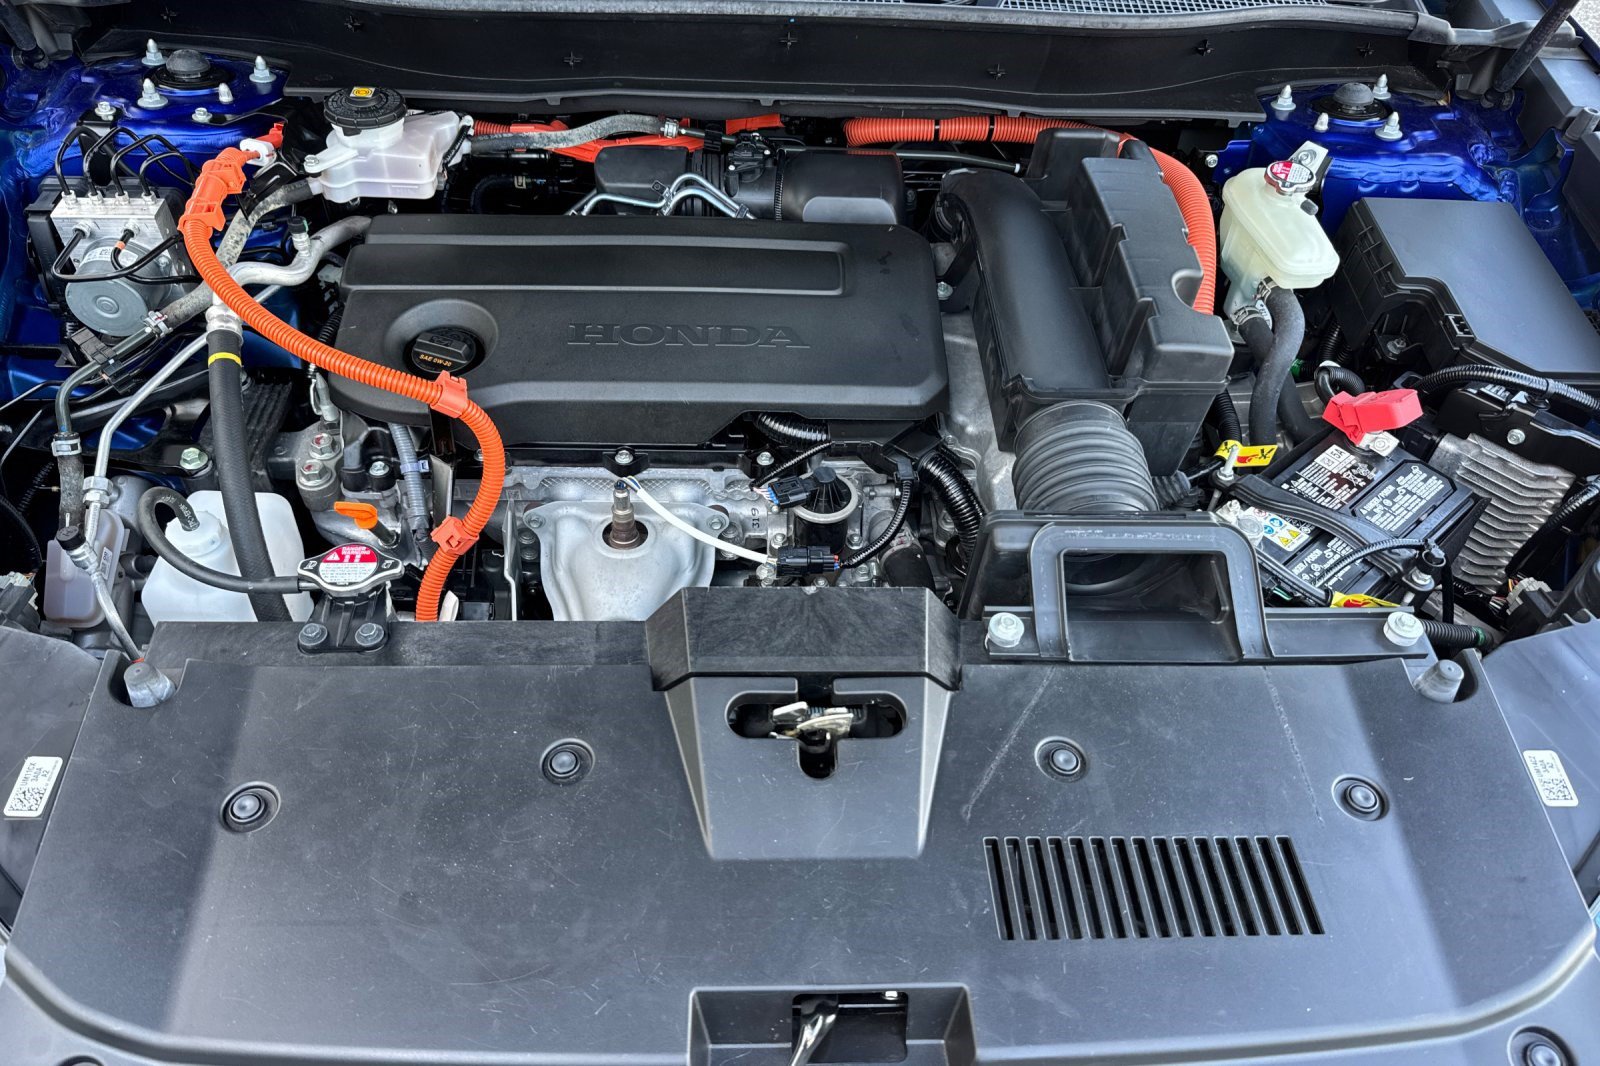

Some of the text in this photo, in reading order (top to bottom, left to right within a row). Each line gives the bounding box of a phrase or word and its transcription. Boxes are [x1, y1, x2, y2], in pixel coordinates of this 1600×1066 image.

[567, 322, 811, 349] HONDA
[419, 354, 453, 367] SAE 0W-20
[750, 507, 760, 529] 319
